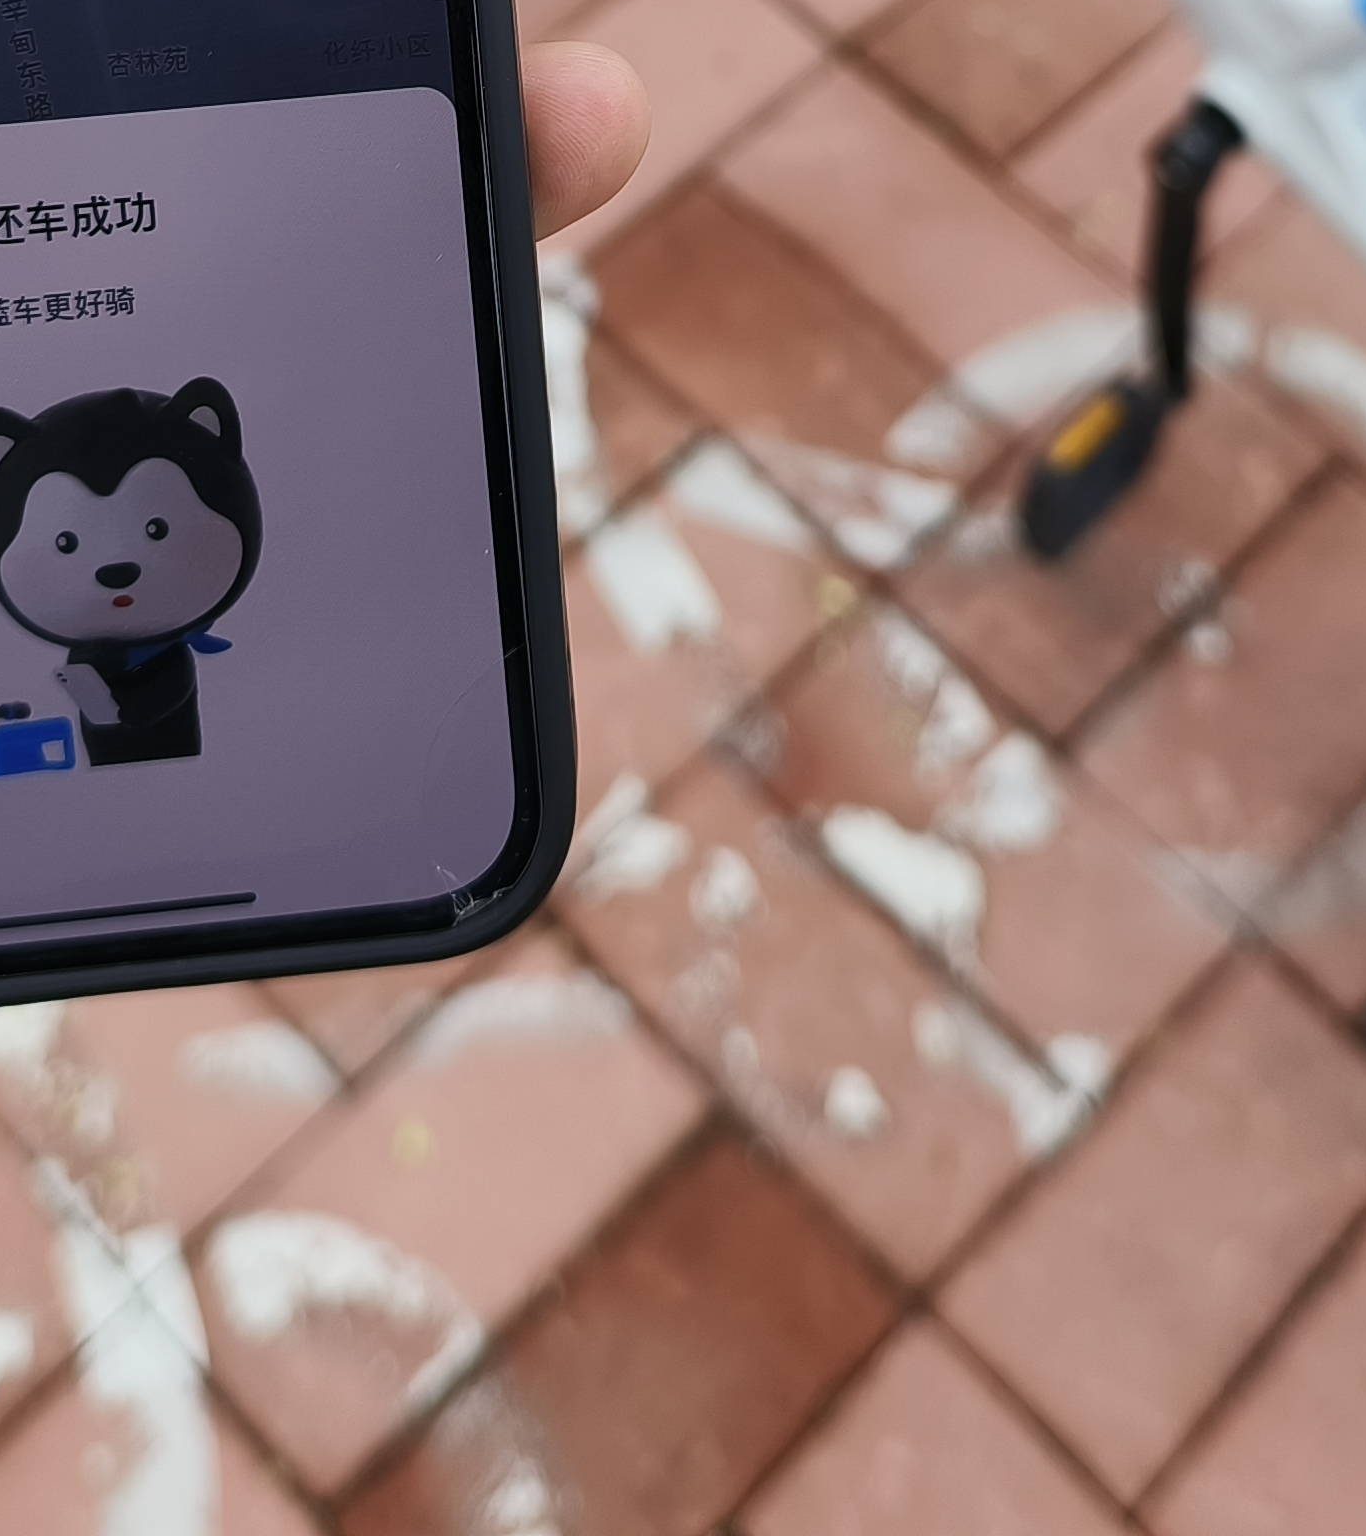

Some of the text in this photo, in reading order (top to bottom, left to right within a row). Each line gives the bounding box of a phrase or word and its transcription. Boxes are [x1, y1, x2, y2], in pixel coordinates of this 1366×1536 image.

[107, 45, 189, 77] 杏林苑
[323, 32, 432, 67] 化纤小区
